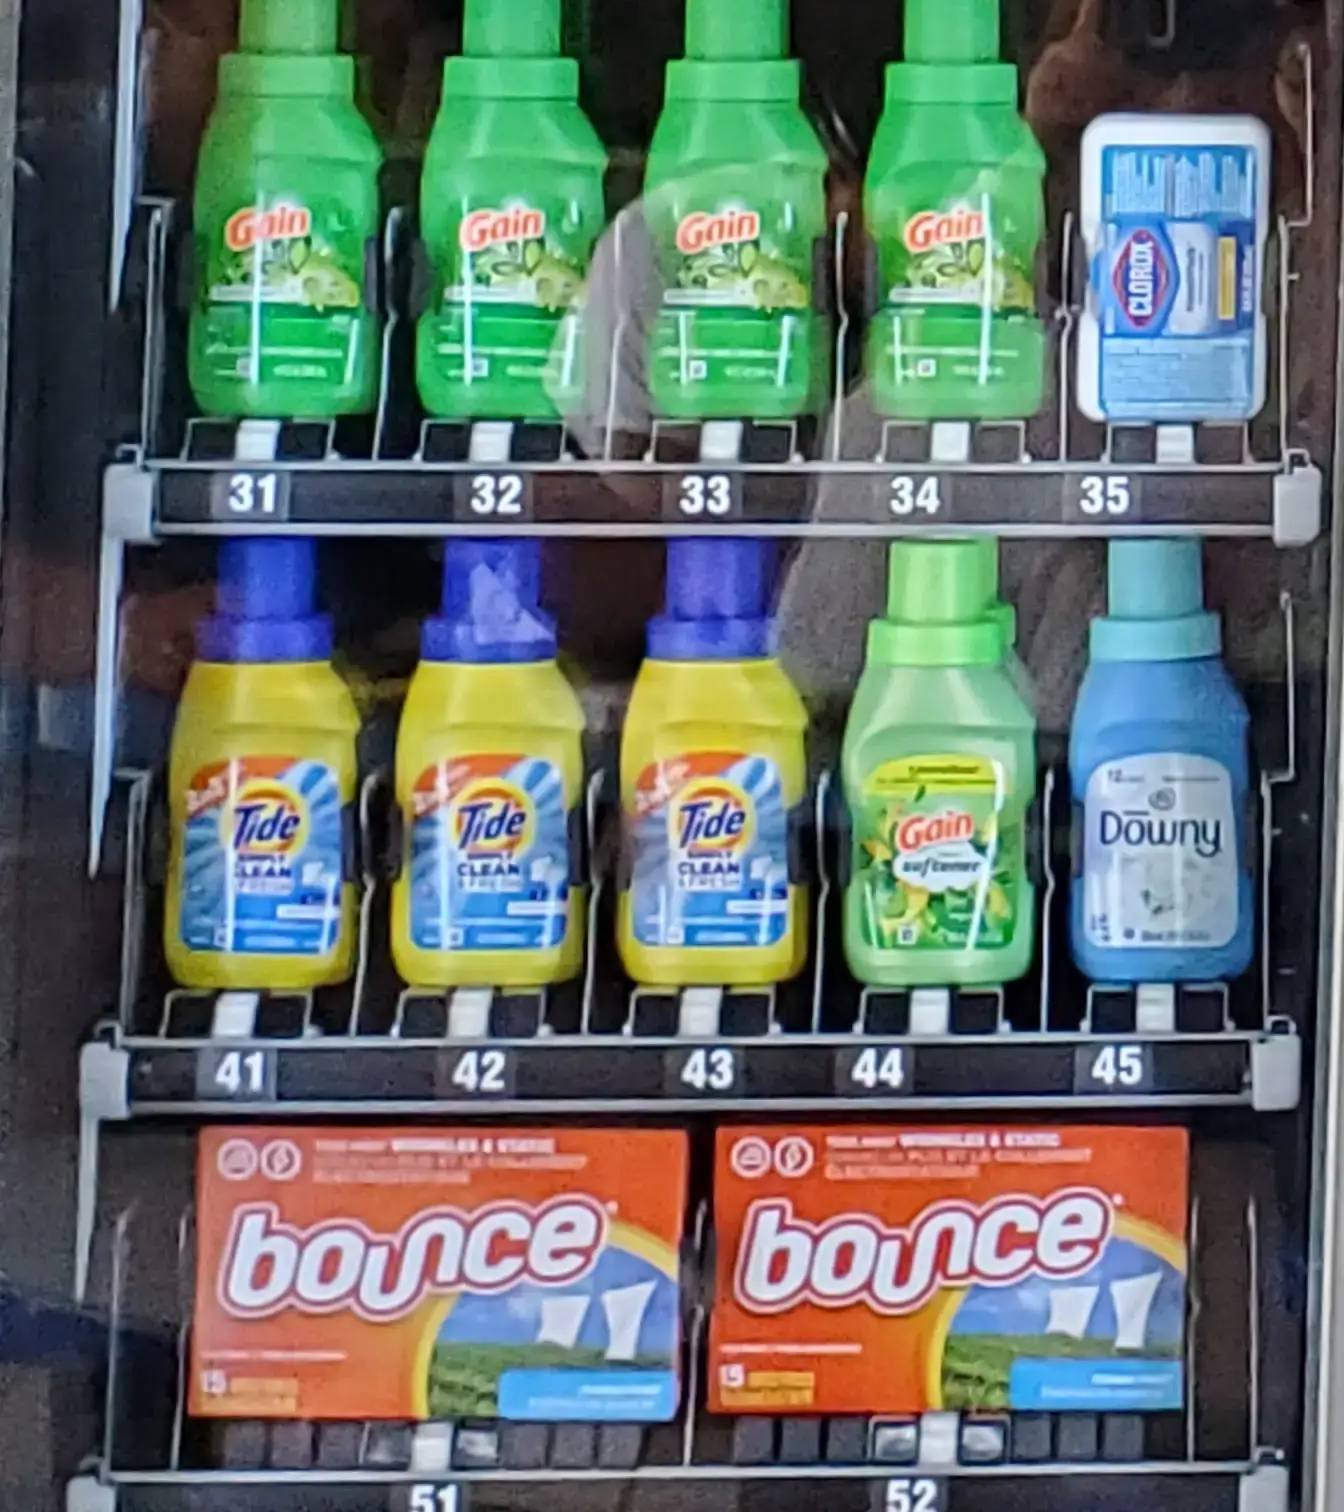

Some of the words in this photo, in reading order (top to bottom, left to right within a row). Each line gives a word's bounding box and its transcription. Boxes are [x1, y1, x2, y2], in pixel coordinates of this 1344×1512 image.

[227, 208, 310, 249] Gain
[462, 209, 543, 250] Gain
[678, 211, 760, 251] Gain
[908, 212, 985, 251] Gain
[1127, 240, 1154, 317] CLOROX
[227, 473, 277, 514] 31
[470, 475, 522, 515] 32
[679, 475, 732, 515] 33
[889, 476, 941, 515] 34
[1079, 476, 1131, 515] 35
[234, 801, 301, 848] Tide
[457, 800, 527, 851] Tide
[679, 799, 747, 849] Tide
[899, 810, 973, 851] Gain
[1100, 810, 1222, 858] Downy
[457, 862, 520, 878] CLEAN
[678, 861, 740, 875] CLEAN
[215, 1050, 264, 1090] 41
[452, 1050, 506, 1090] 42
[681, 1049, 734, 1090] 43
[851, 1048, 904, 1089] 44
[1091, 1045, 1143, 1086] 45
[224, 1197, 604, 1316] bounce
[740, 1192, 1111, 1309] bounce
[409, 1484, 458, 1512] 51
[885, 1480, 937, 1512] 52
